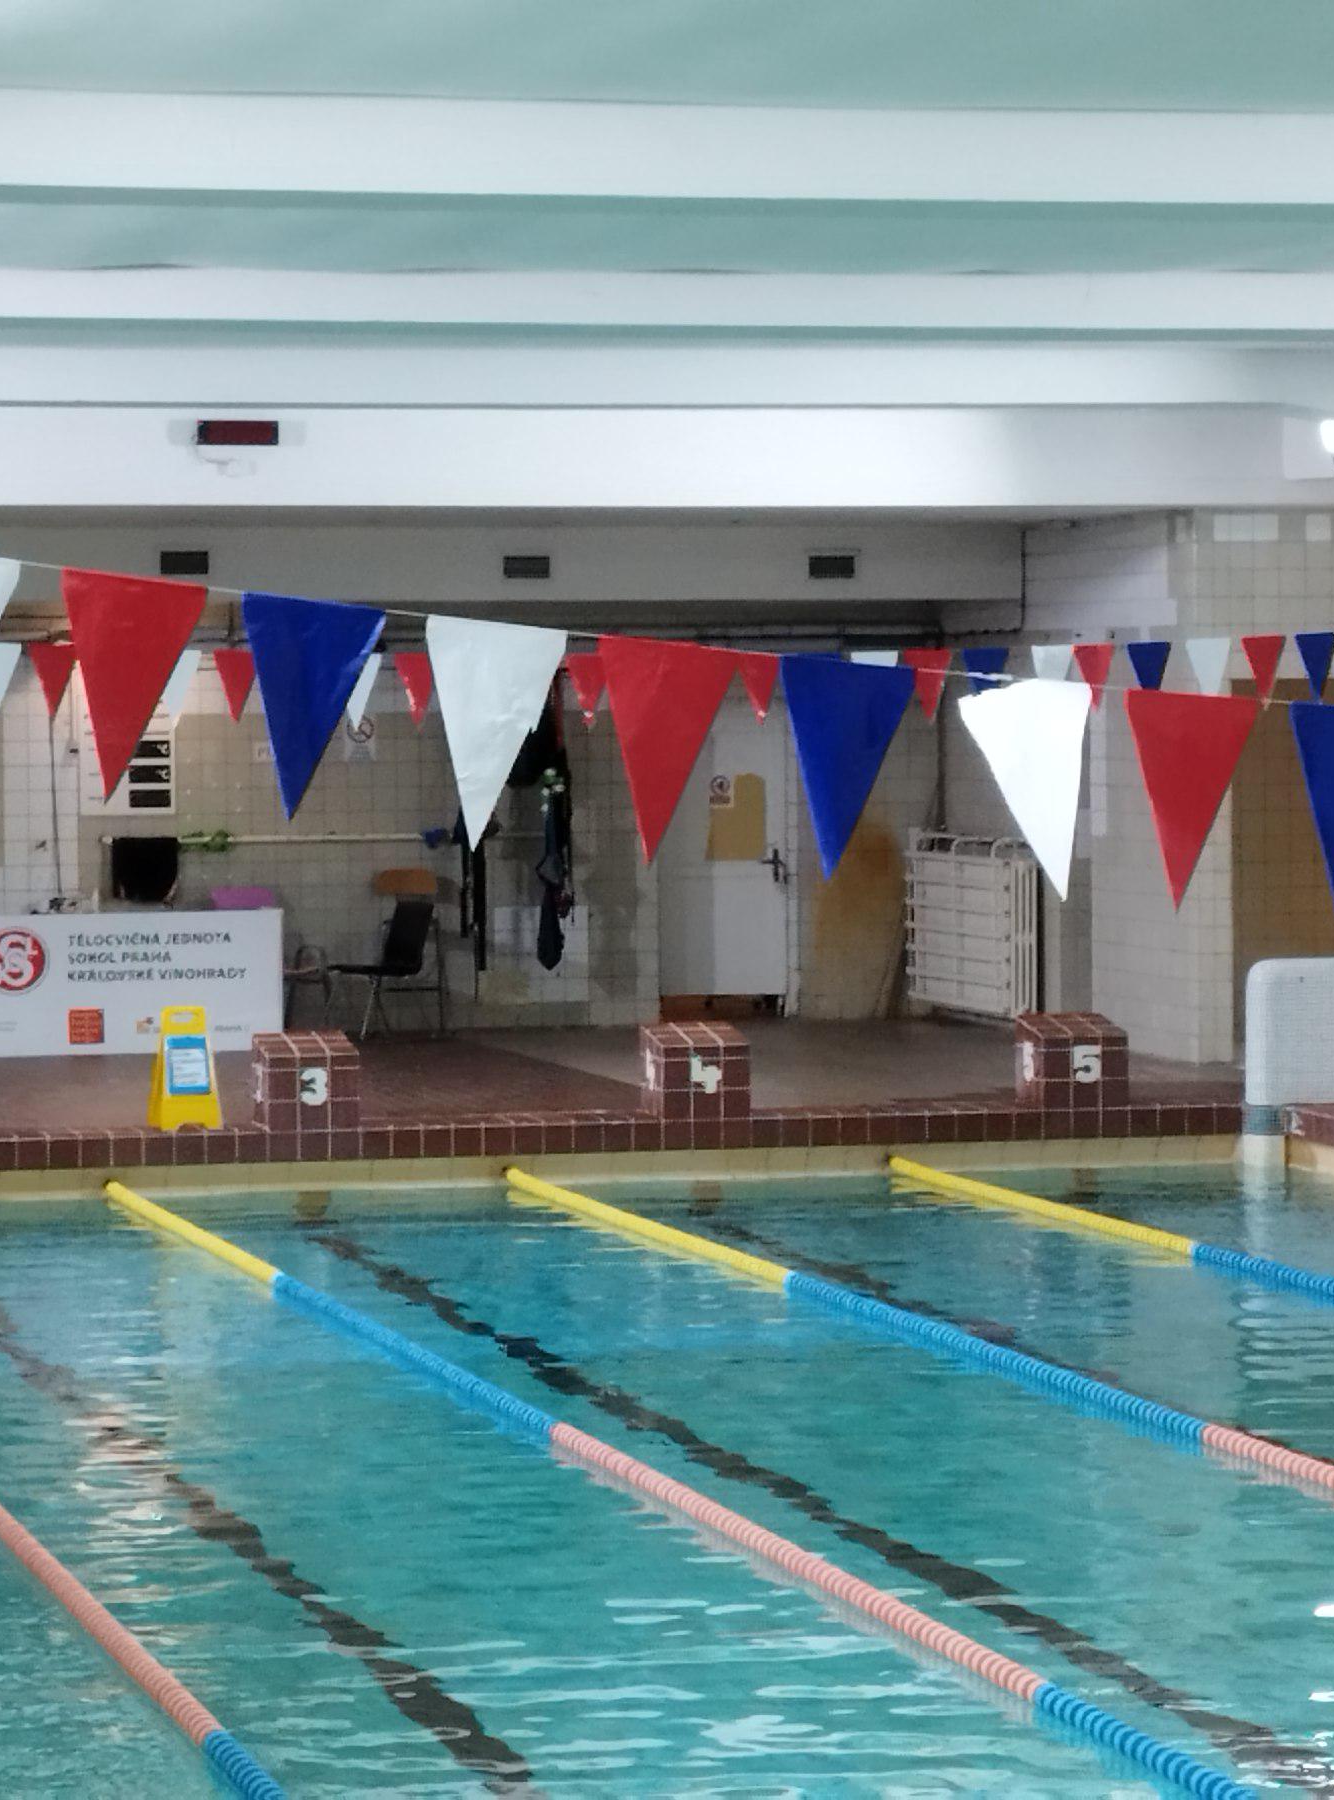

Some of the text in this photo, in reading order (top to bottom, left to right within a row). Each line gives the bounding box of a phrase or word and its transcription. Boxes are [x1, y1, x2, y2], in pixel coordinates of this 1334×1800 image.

[67, 931, 232, 947] TĚLOCVIČNÁ JEDNOTA
[67, 951, 172, 965] SOKOL PRAHA
[67, 967, 247, 982] KRÁLOVSKÉ VINOHRADY
[691, 1055, 722, 1093] 4
[1073, 1044, 1102, 1084] 5
[299, 1067, 328, 1106] 3
